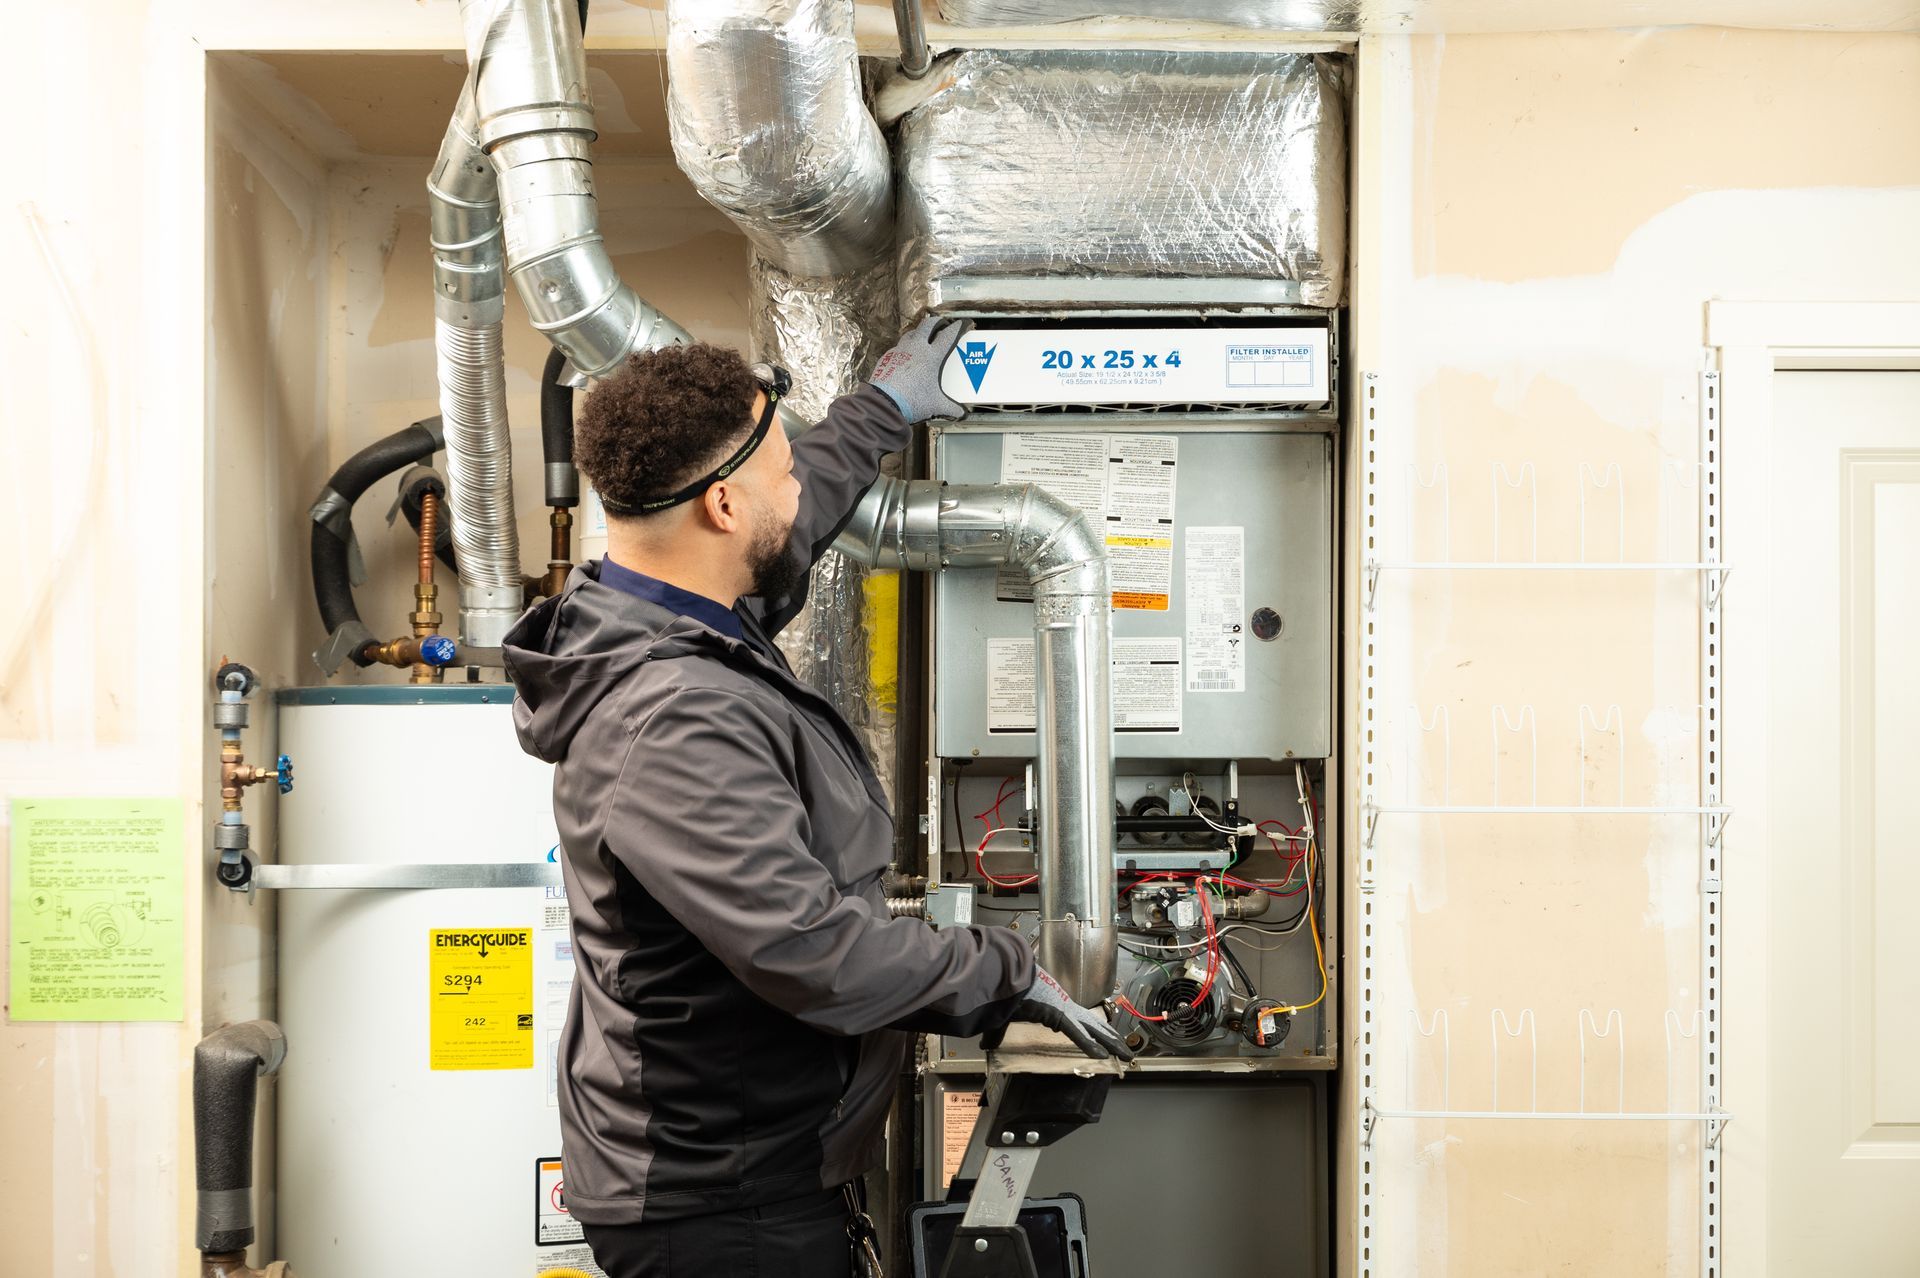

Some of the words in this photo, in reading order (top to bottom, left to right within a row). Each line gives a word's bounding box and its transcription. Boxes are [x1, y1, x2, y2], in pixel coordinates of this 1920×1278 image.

[1041, 350, 1073, 369] 20
[1081, 354, 1096, 369] x
[1103, 350, 1135, 369] 25
[1142, 354, 1158, 369] x
[1165, 350, 1181, 368] 4
[436, 933, 527, 948] ENERGYGUIDE
[444, 974, 482, 986] $294
[465, 1017, 486, 1026] 242
